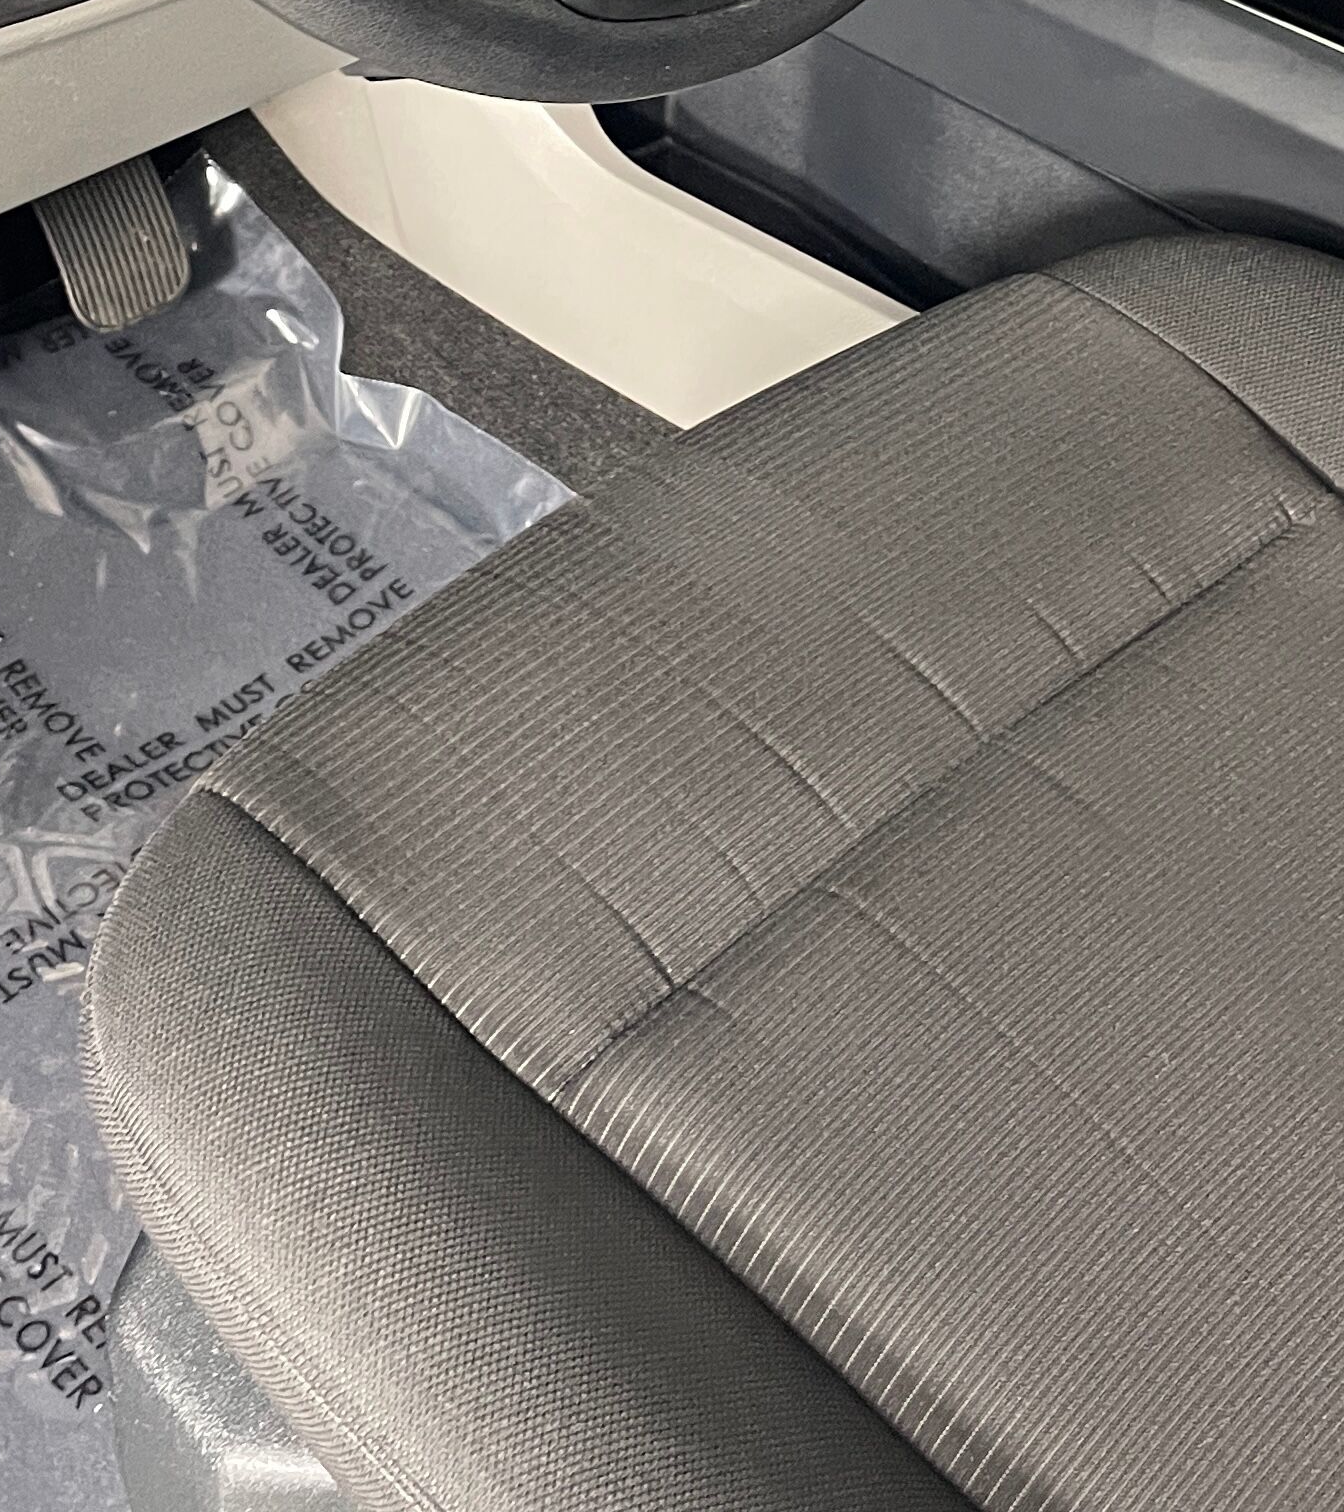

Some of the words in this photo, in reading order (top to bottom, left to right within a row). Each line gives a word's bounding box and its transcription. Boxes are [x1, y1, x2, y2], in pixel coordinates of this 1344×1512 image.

[199, 447, 265, 519] MUST
[246, 455, 389, 582] PROTECTIVE
[262, 522, 356, 606] DEALER
[58, 731, 184, 802] DEALER
[194, 672, 276, 732] MUST
[285, 578, 416, 673] REMOVE
